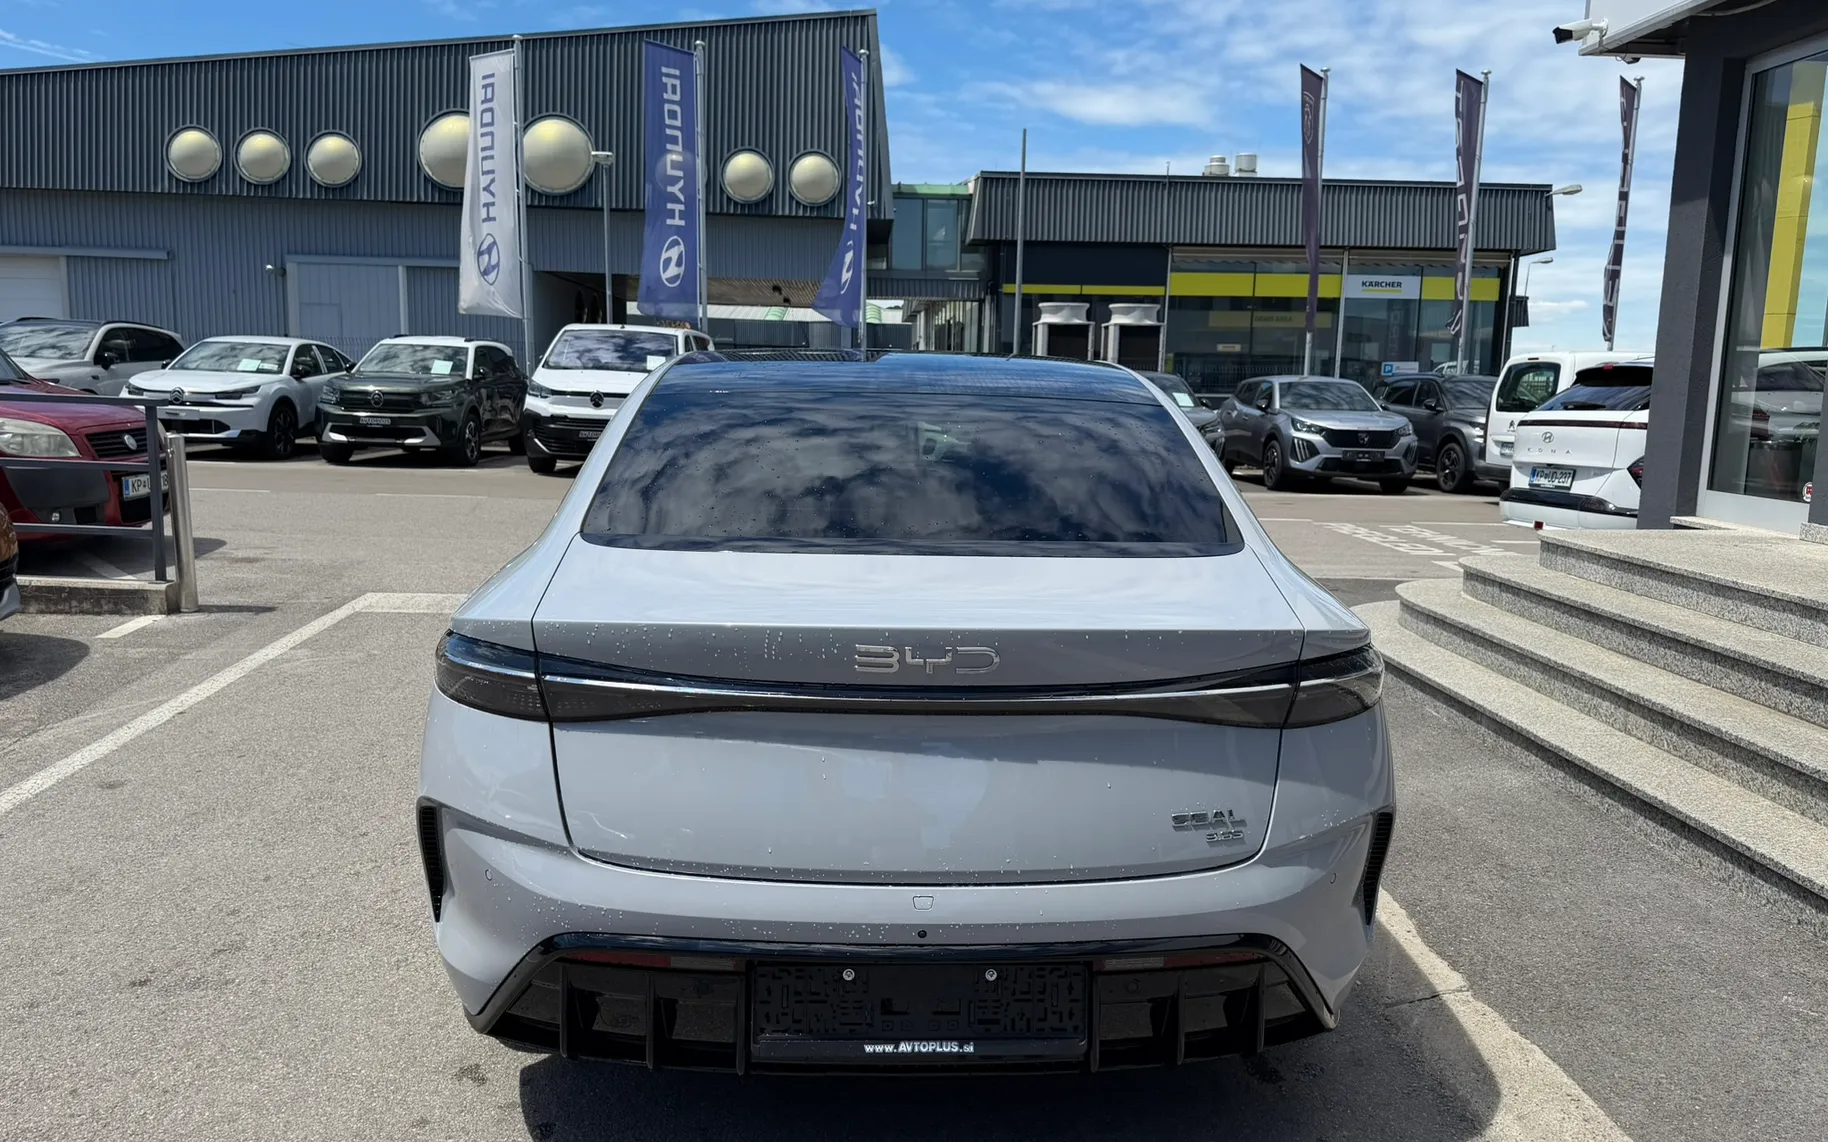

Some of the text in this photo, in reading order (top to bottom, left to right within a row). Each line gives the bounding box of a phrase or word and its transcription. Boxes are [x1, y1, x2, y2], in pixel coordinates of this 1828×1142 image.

[1361, 280, 1403, 289] KÄRCHER
[1527, 447, 1572, 455] KONA
[855, 644, 1000, 674] BYD
[1171, 809, 1244, 826] SEAL
[863, 1041, 975, 1053] www.AVTOPLUS.si
